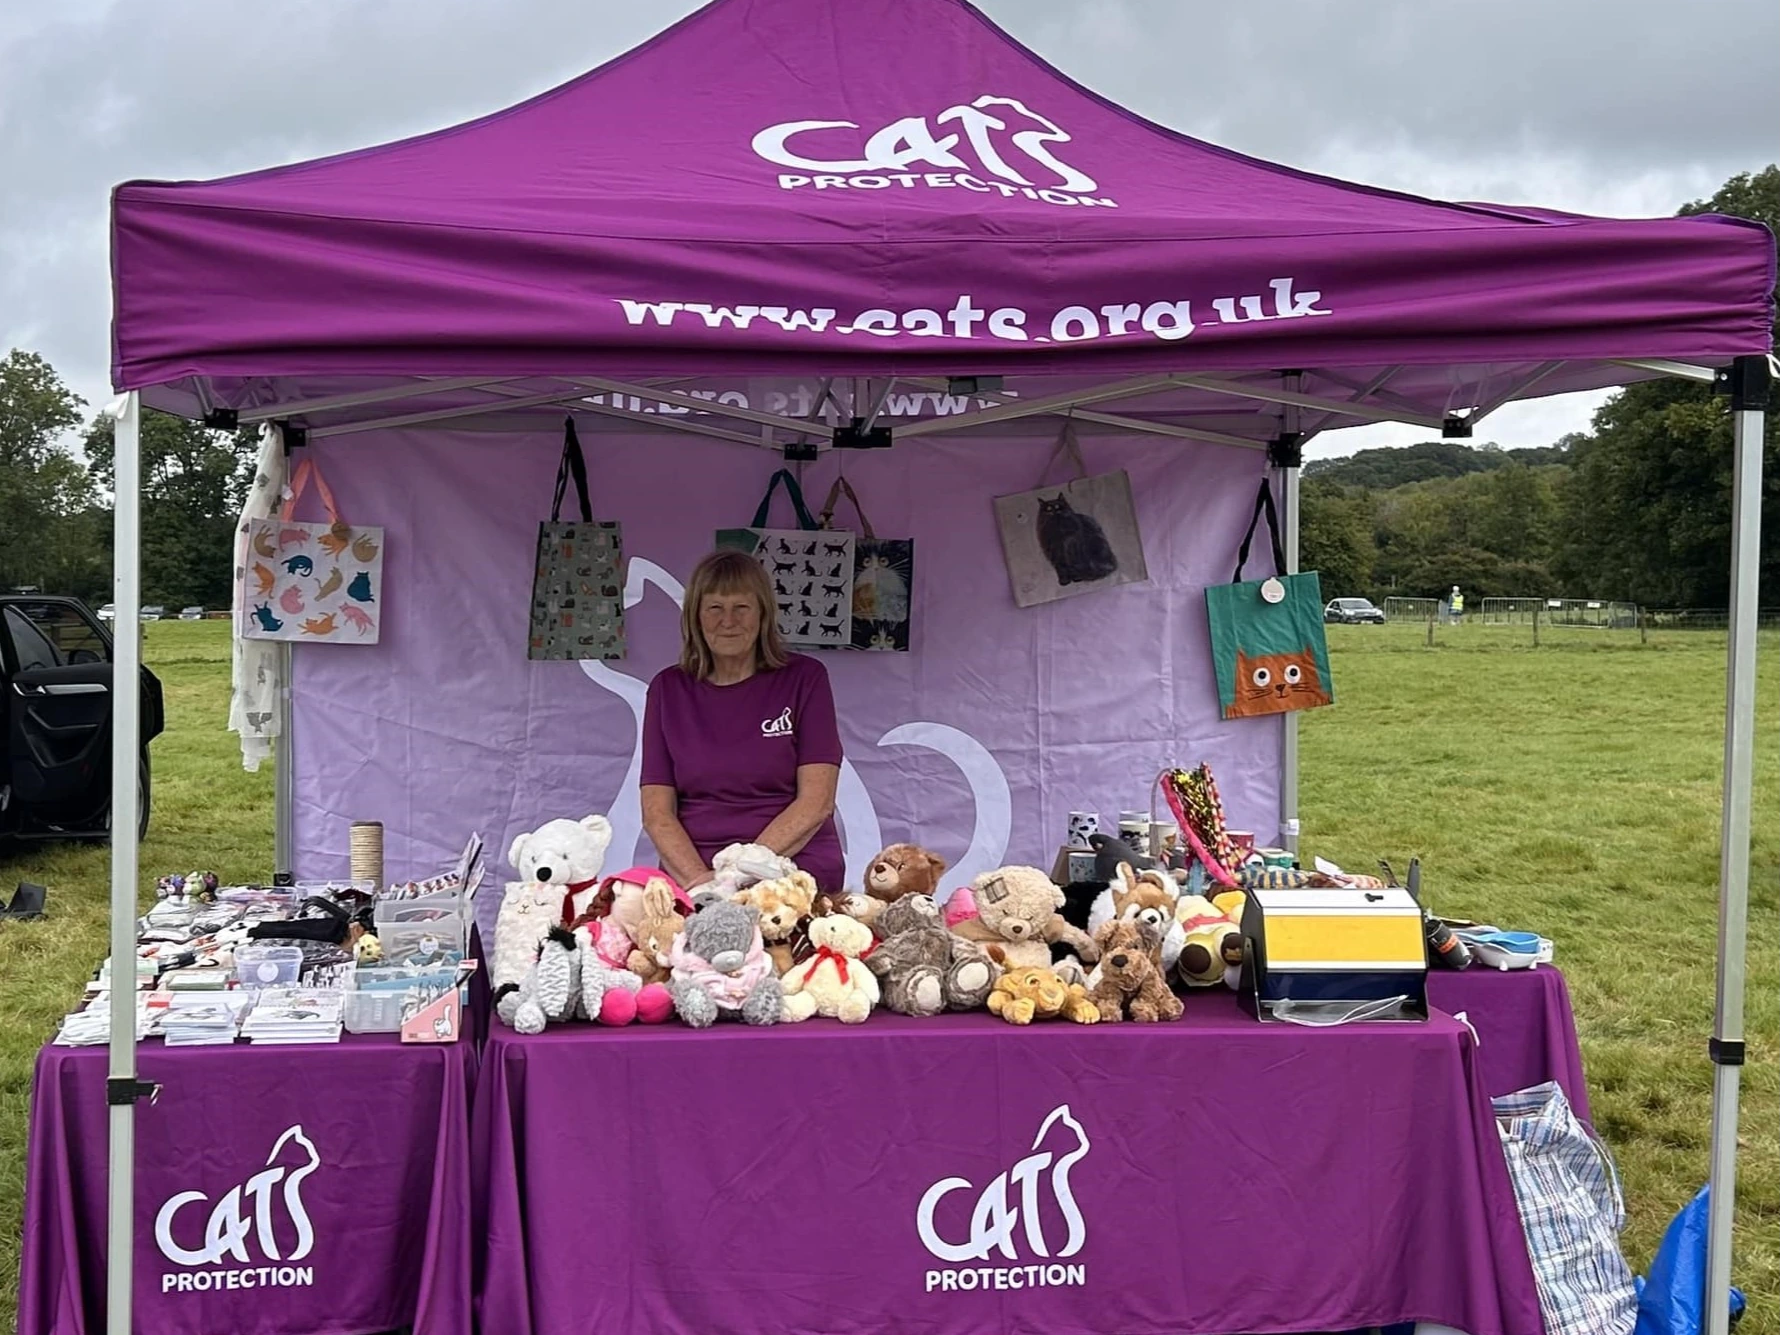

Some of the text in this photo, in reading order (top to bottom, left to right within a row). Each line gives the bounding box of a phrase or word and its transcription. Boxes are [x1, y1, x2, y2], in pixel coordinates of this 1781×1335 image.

[751, 94, 1098, 193] CATS
[777, 173, 1119, 208] PROTECTION
[612, 277, 1333, 342] www.catsorguk
[155, 1124, 321, 1266] CATS
[916, 1104, 1091, 1262] CATS
[161, 1266, 313, 1293] PROTECTION
[926, 1264, 1086, 1293] PROTECTION
